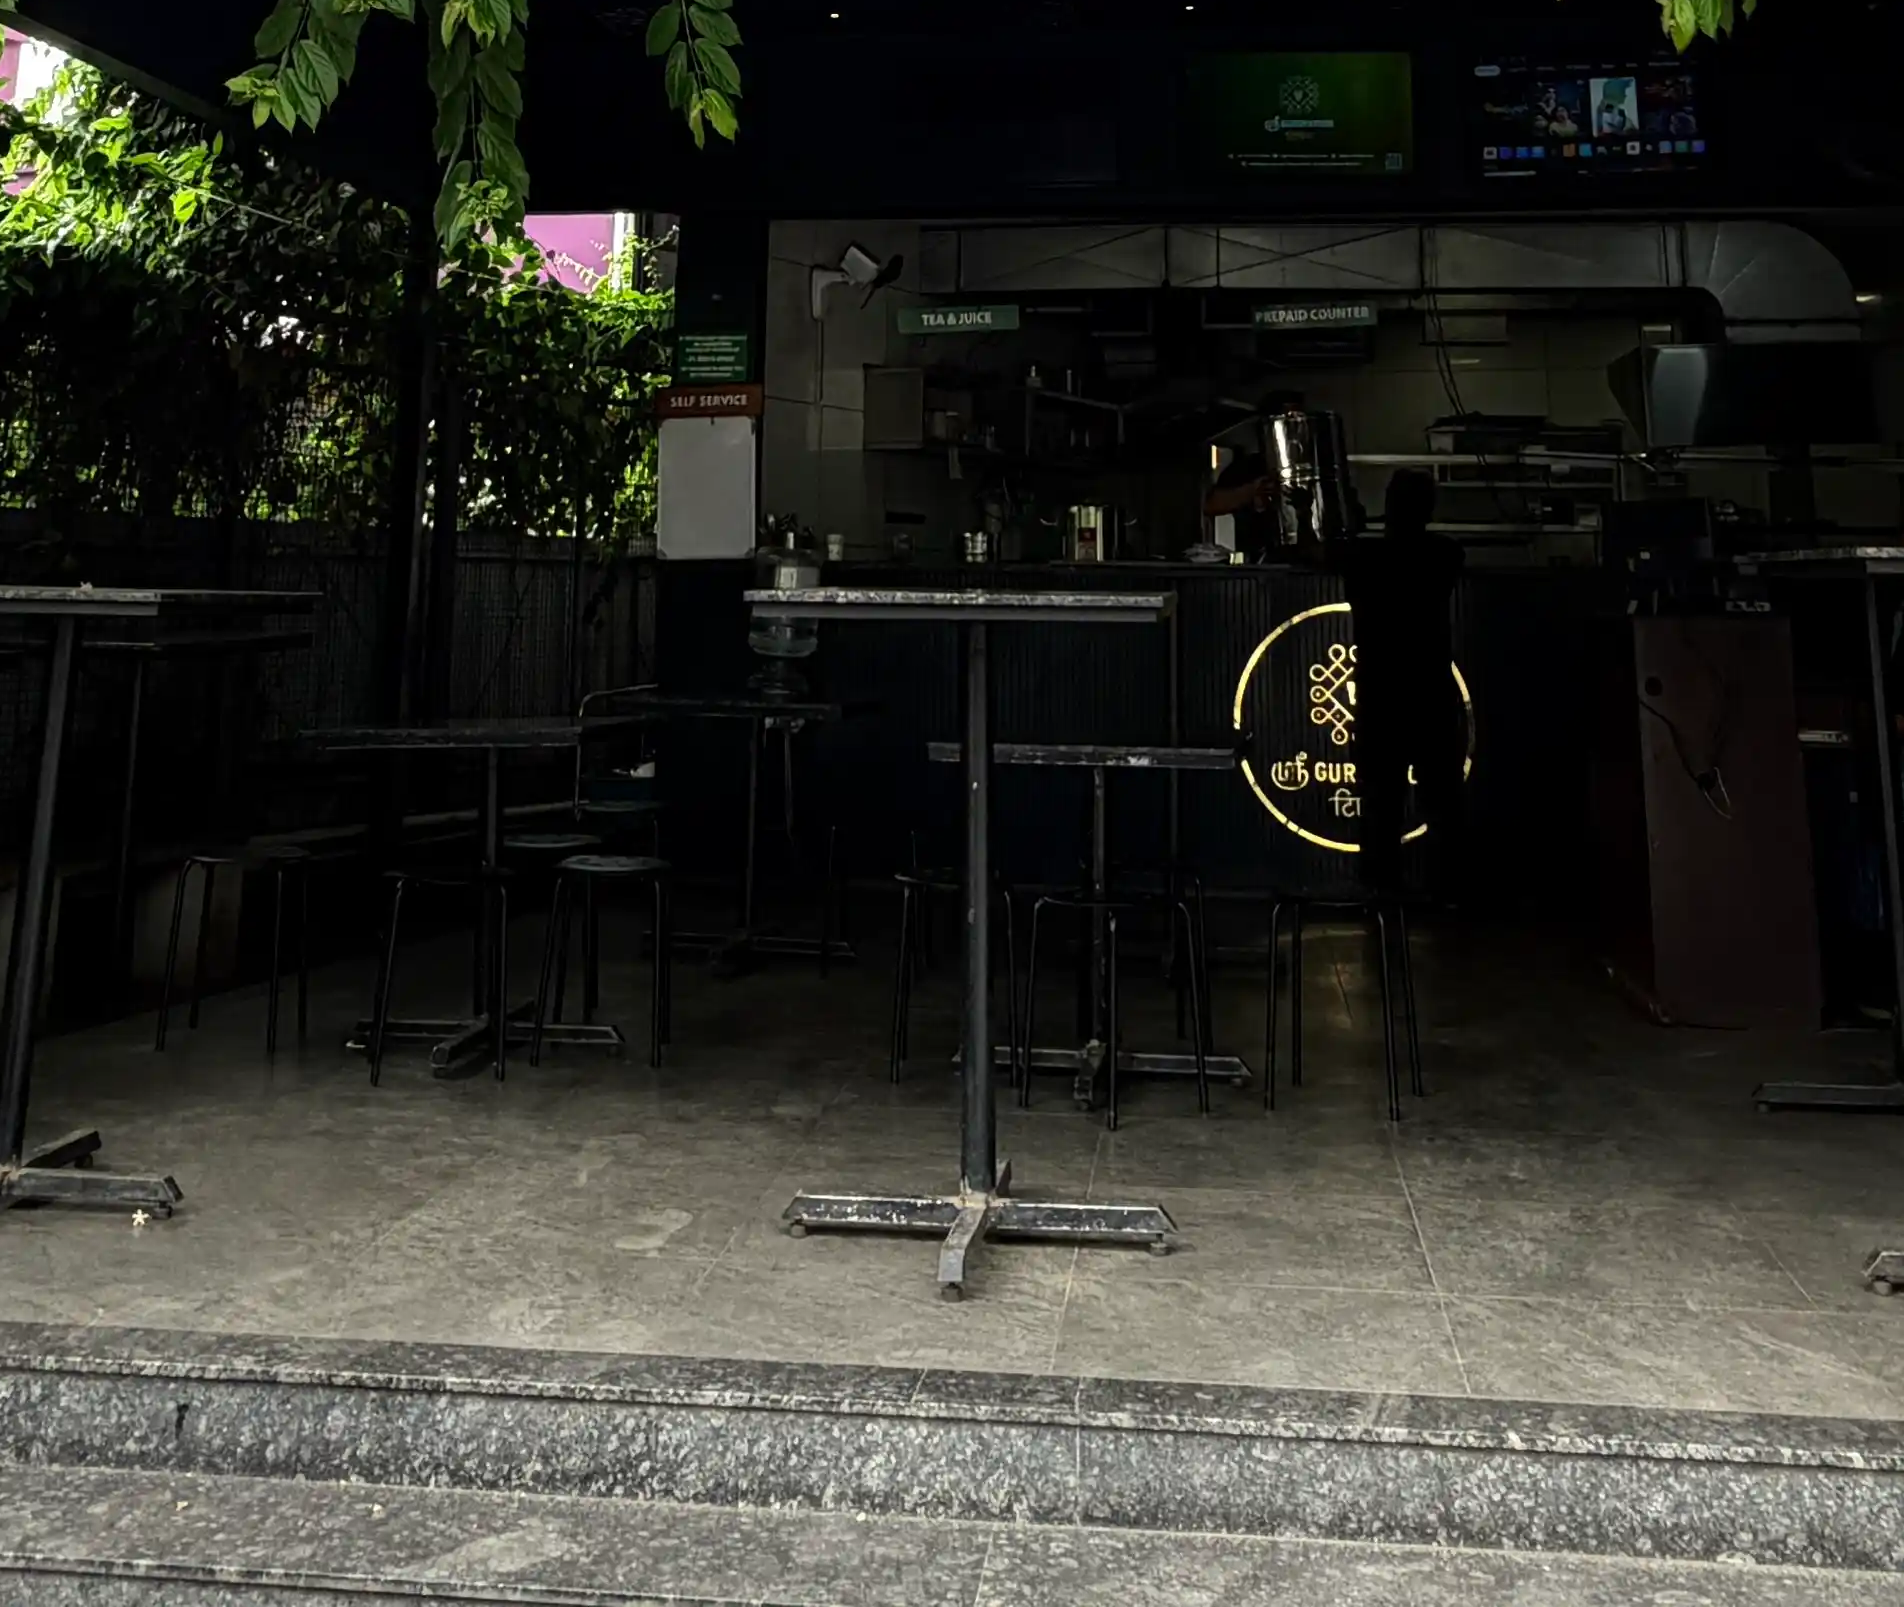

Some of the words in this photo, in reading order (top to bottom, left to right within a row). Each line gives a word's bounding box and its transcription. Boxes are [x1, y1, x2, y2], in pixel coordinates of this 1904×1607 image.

[921, 313, 945, 327] TEA
[947, 312, 956, 325] &
[958, 310, 994, 325] JUICE
[1254, 308, 1309, 324] PREPAID
[1310, 305, 1370, 321] COUNTER
[669, 395, 696, 409] SELF
[698, 393, 748, 408] SERVICE
